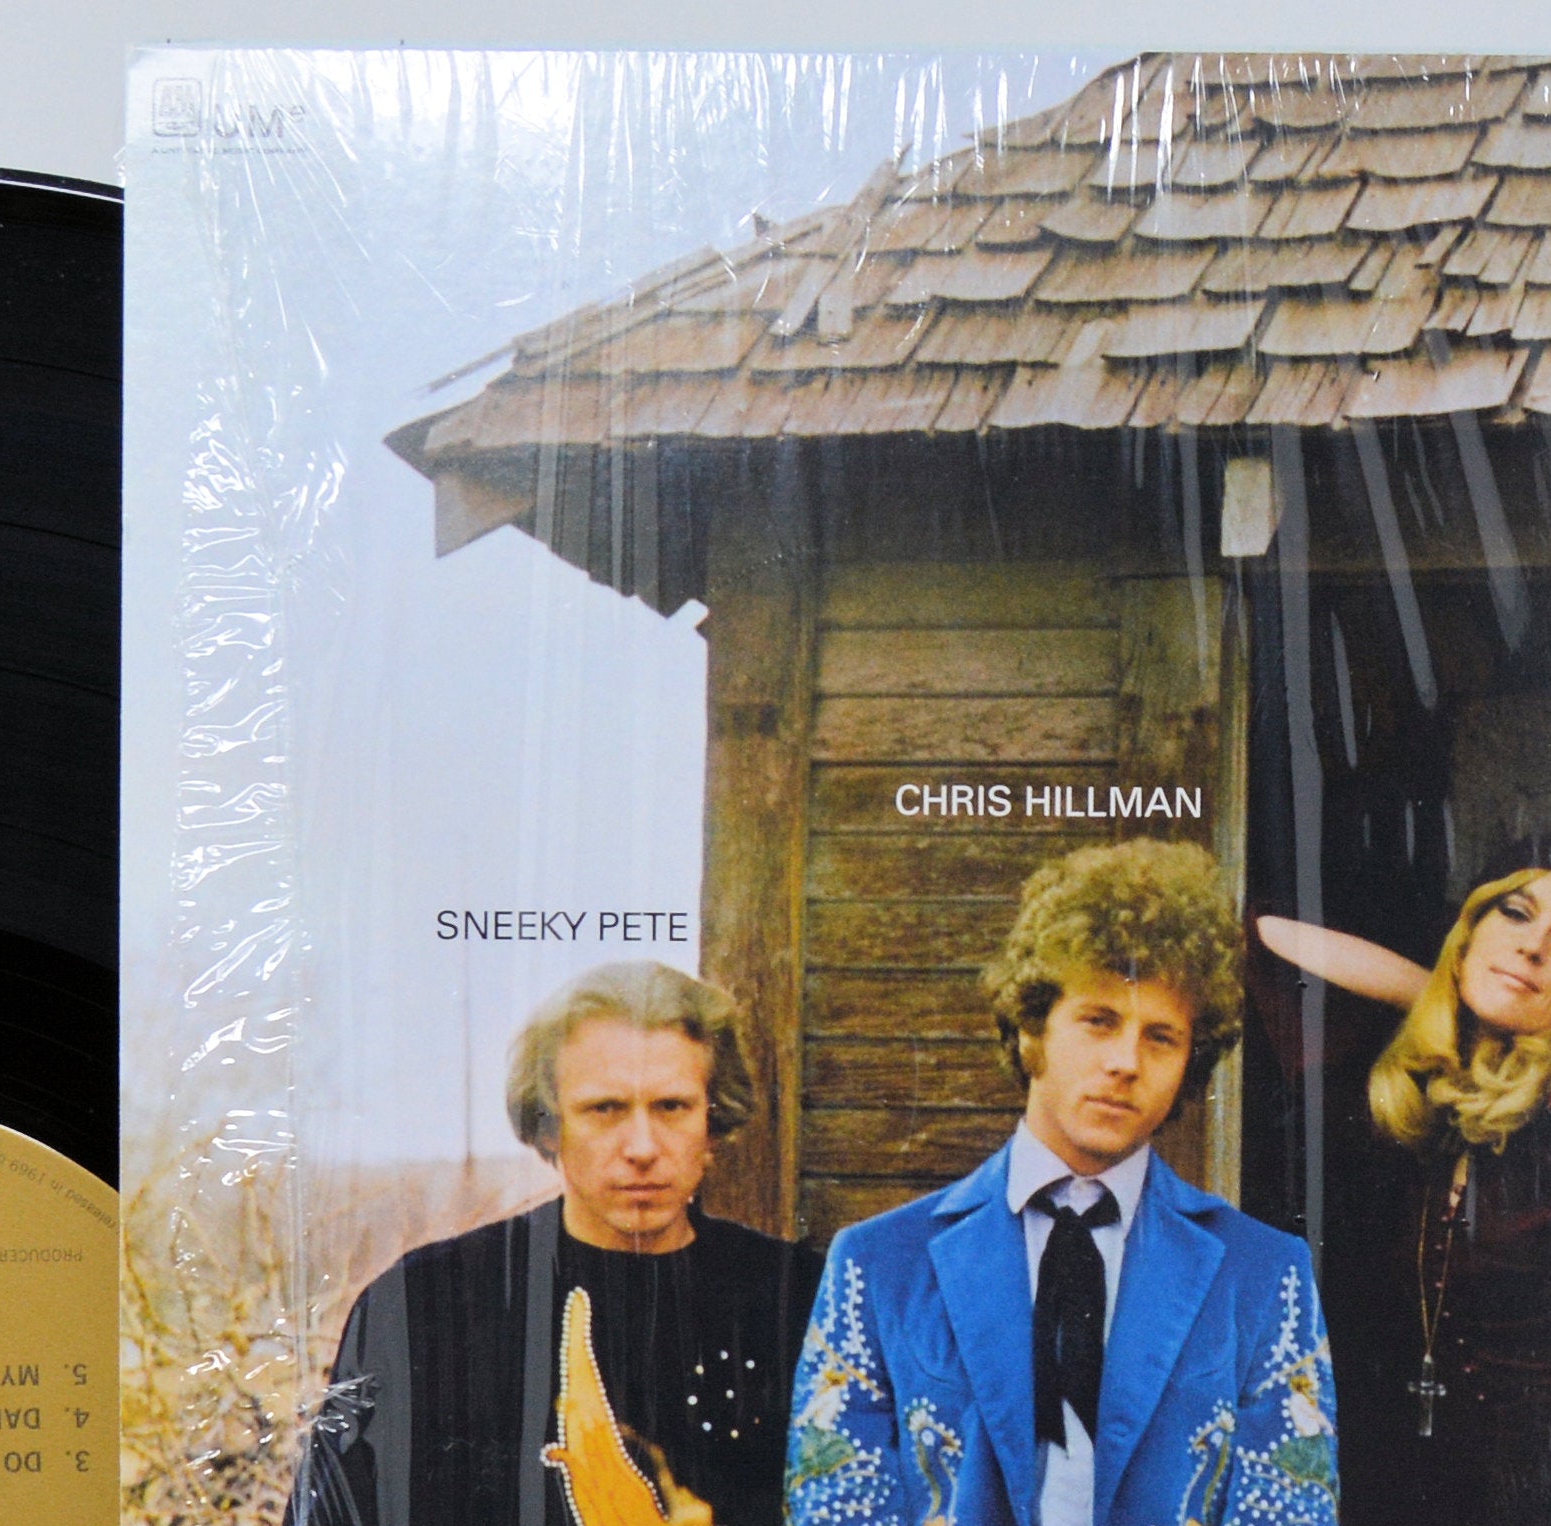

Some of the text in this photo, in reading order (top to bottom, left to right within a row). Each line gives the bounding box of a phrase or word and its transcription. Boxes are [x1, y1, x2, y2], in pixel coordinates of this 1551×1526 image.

[895, 783, 1202, 819] CHRIS HILLMAN
[436, 909, 688, 942] SNEEKY PETE
[0, 1363, 40, 1387] MY
[63, 1362, 88, 1387] 5.
[64, 1406, 91, 1429] 4.
[3, 1449, 43, 1474] DO
[64, 1449, 91, 1473] 3.
